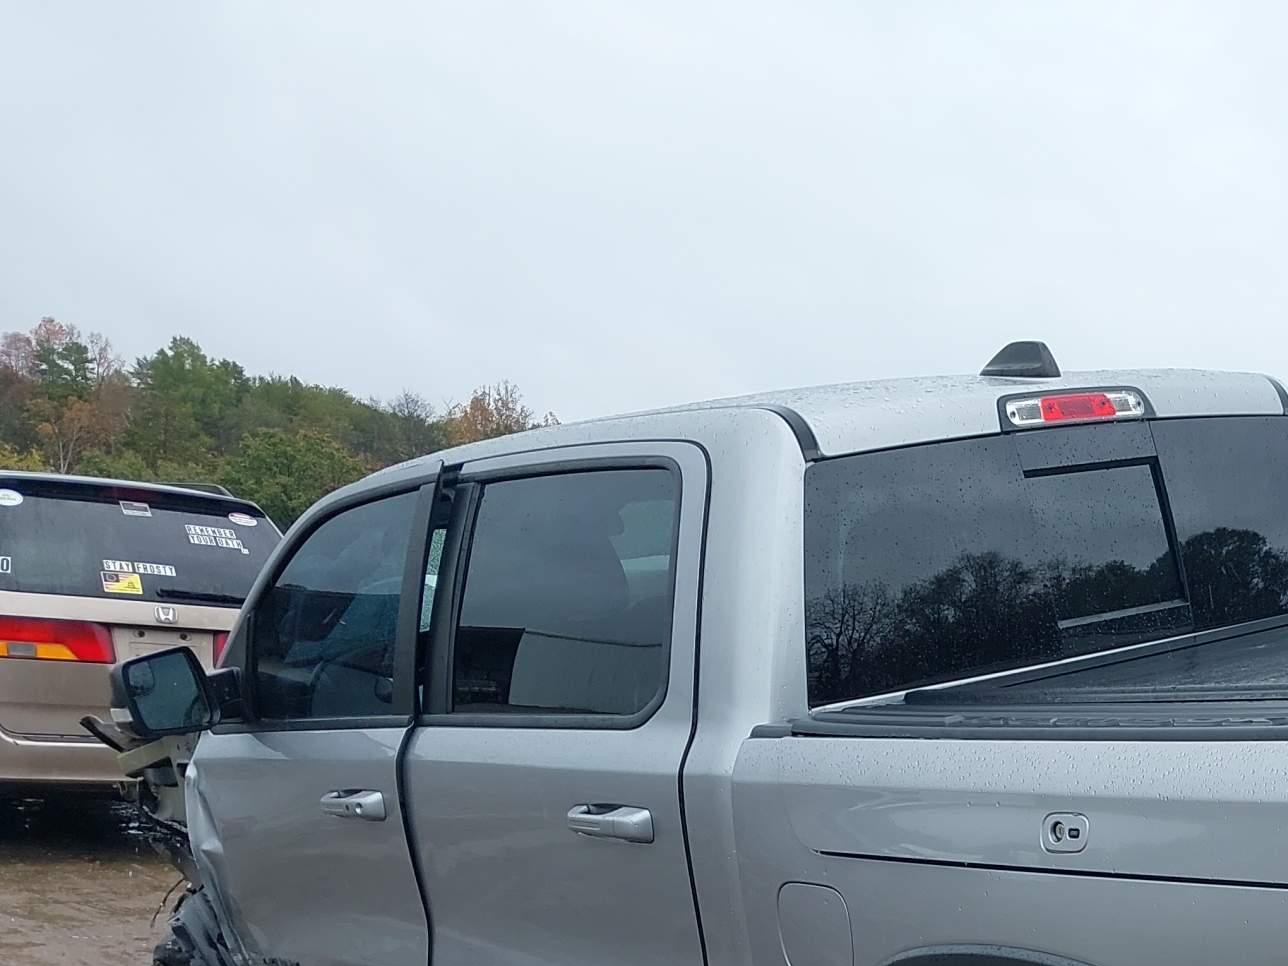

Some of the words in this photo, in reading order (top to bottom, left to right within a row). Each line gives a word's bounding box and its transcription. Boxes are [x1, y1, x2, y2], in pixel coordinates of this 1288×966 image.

[186, 526, 236, 539] REMEMBER
[189, 535, 216, 546] YOUR
[217, 538, 242, 549] OATH
[103, 560, 132, 572] STAY
[135, 563, 175, 576] FROSTY
